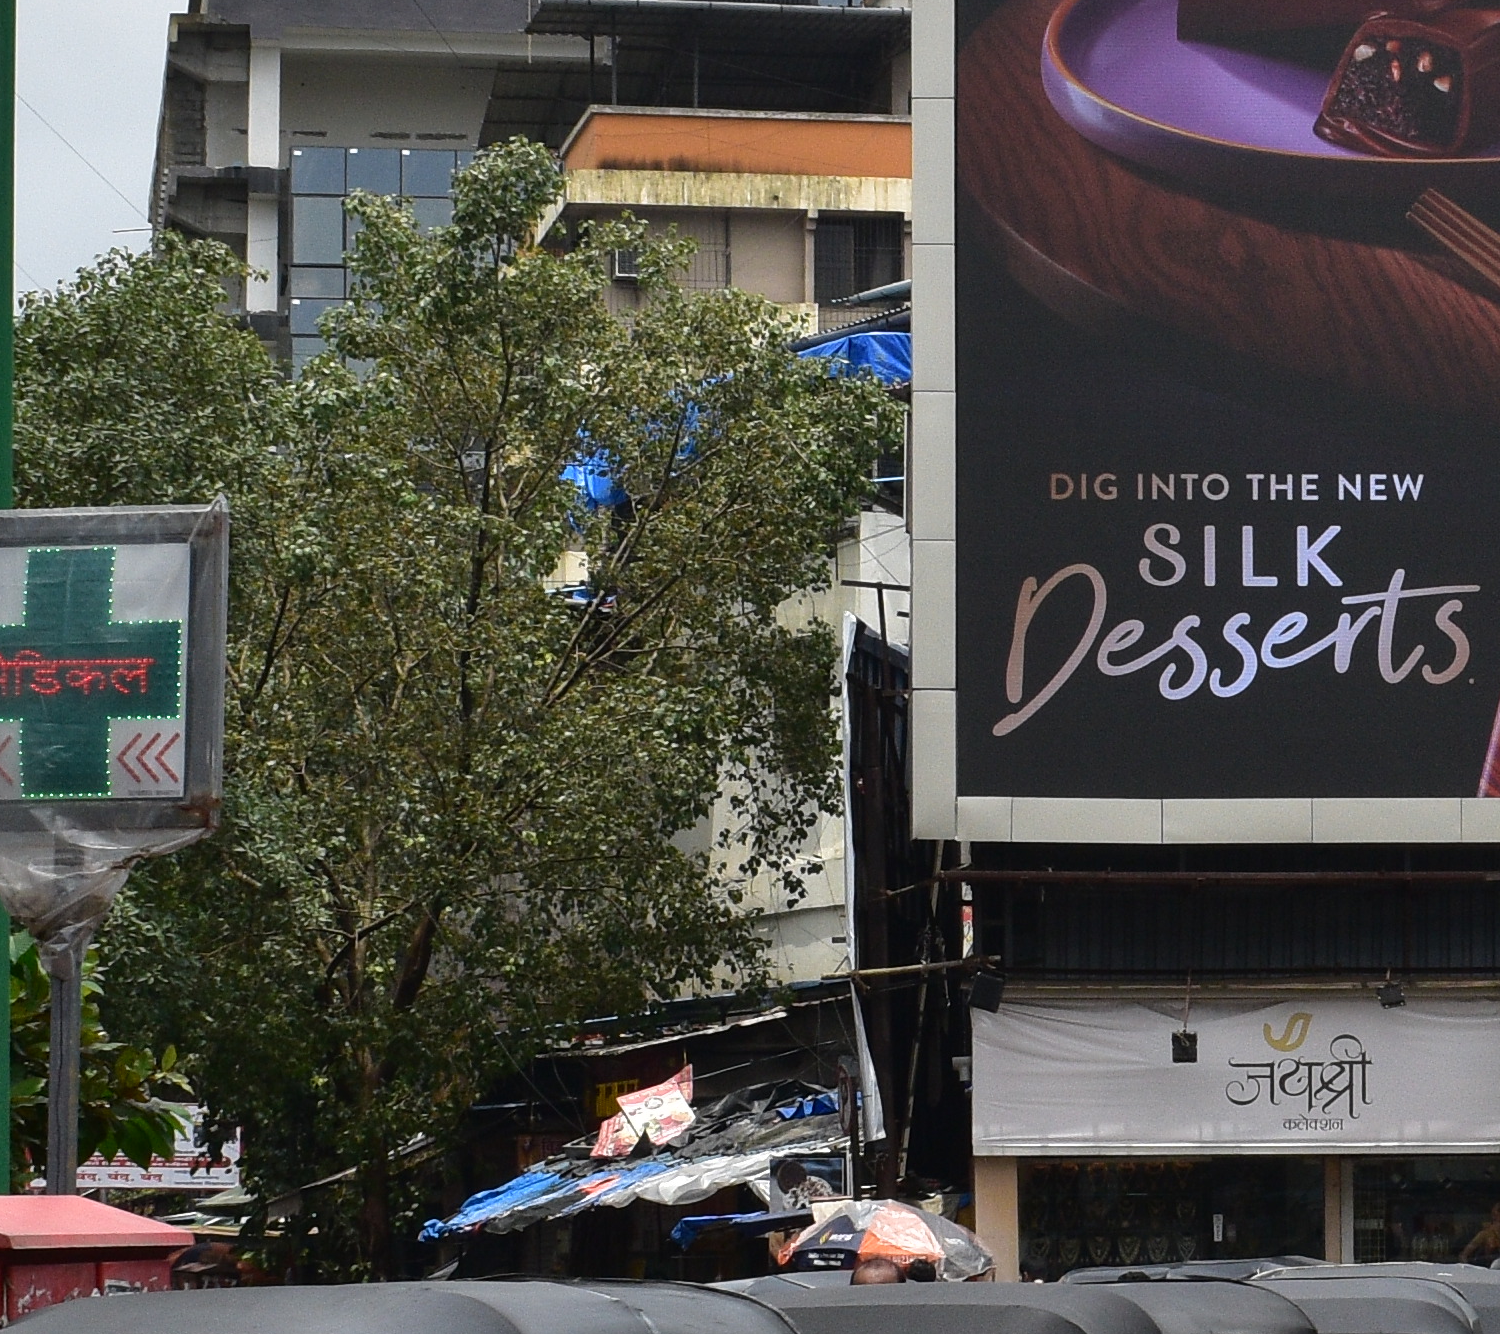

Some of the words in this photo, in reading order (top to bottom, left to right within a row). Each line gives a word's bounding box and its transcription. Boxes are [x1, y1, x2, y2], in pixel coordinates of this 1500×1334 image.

[1049, 473, 1119, 501] DIG
[1137, 473, 1231, 501] INTO
[1246, 473, 1320, 501] THE
[1337, 473, 1425, 501] NEW
[1138, 523, 1344, 587] SILK
[1282, 1113, 1344, 1131] कलेक्शन
